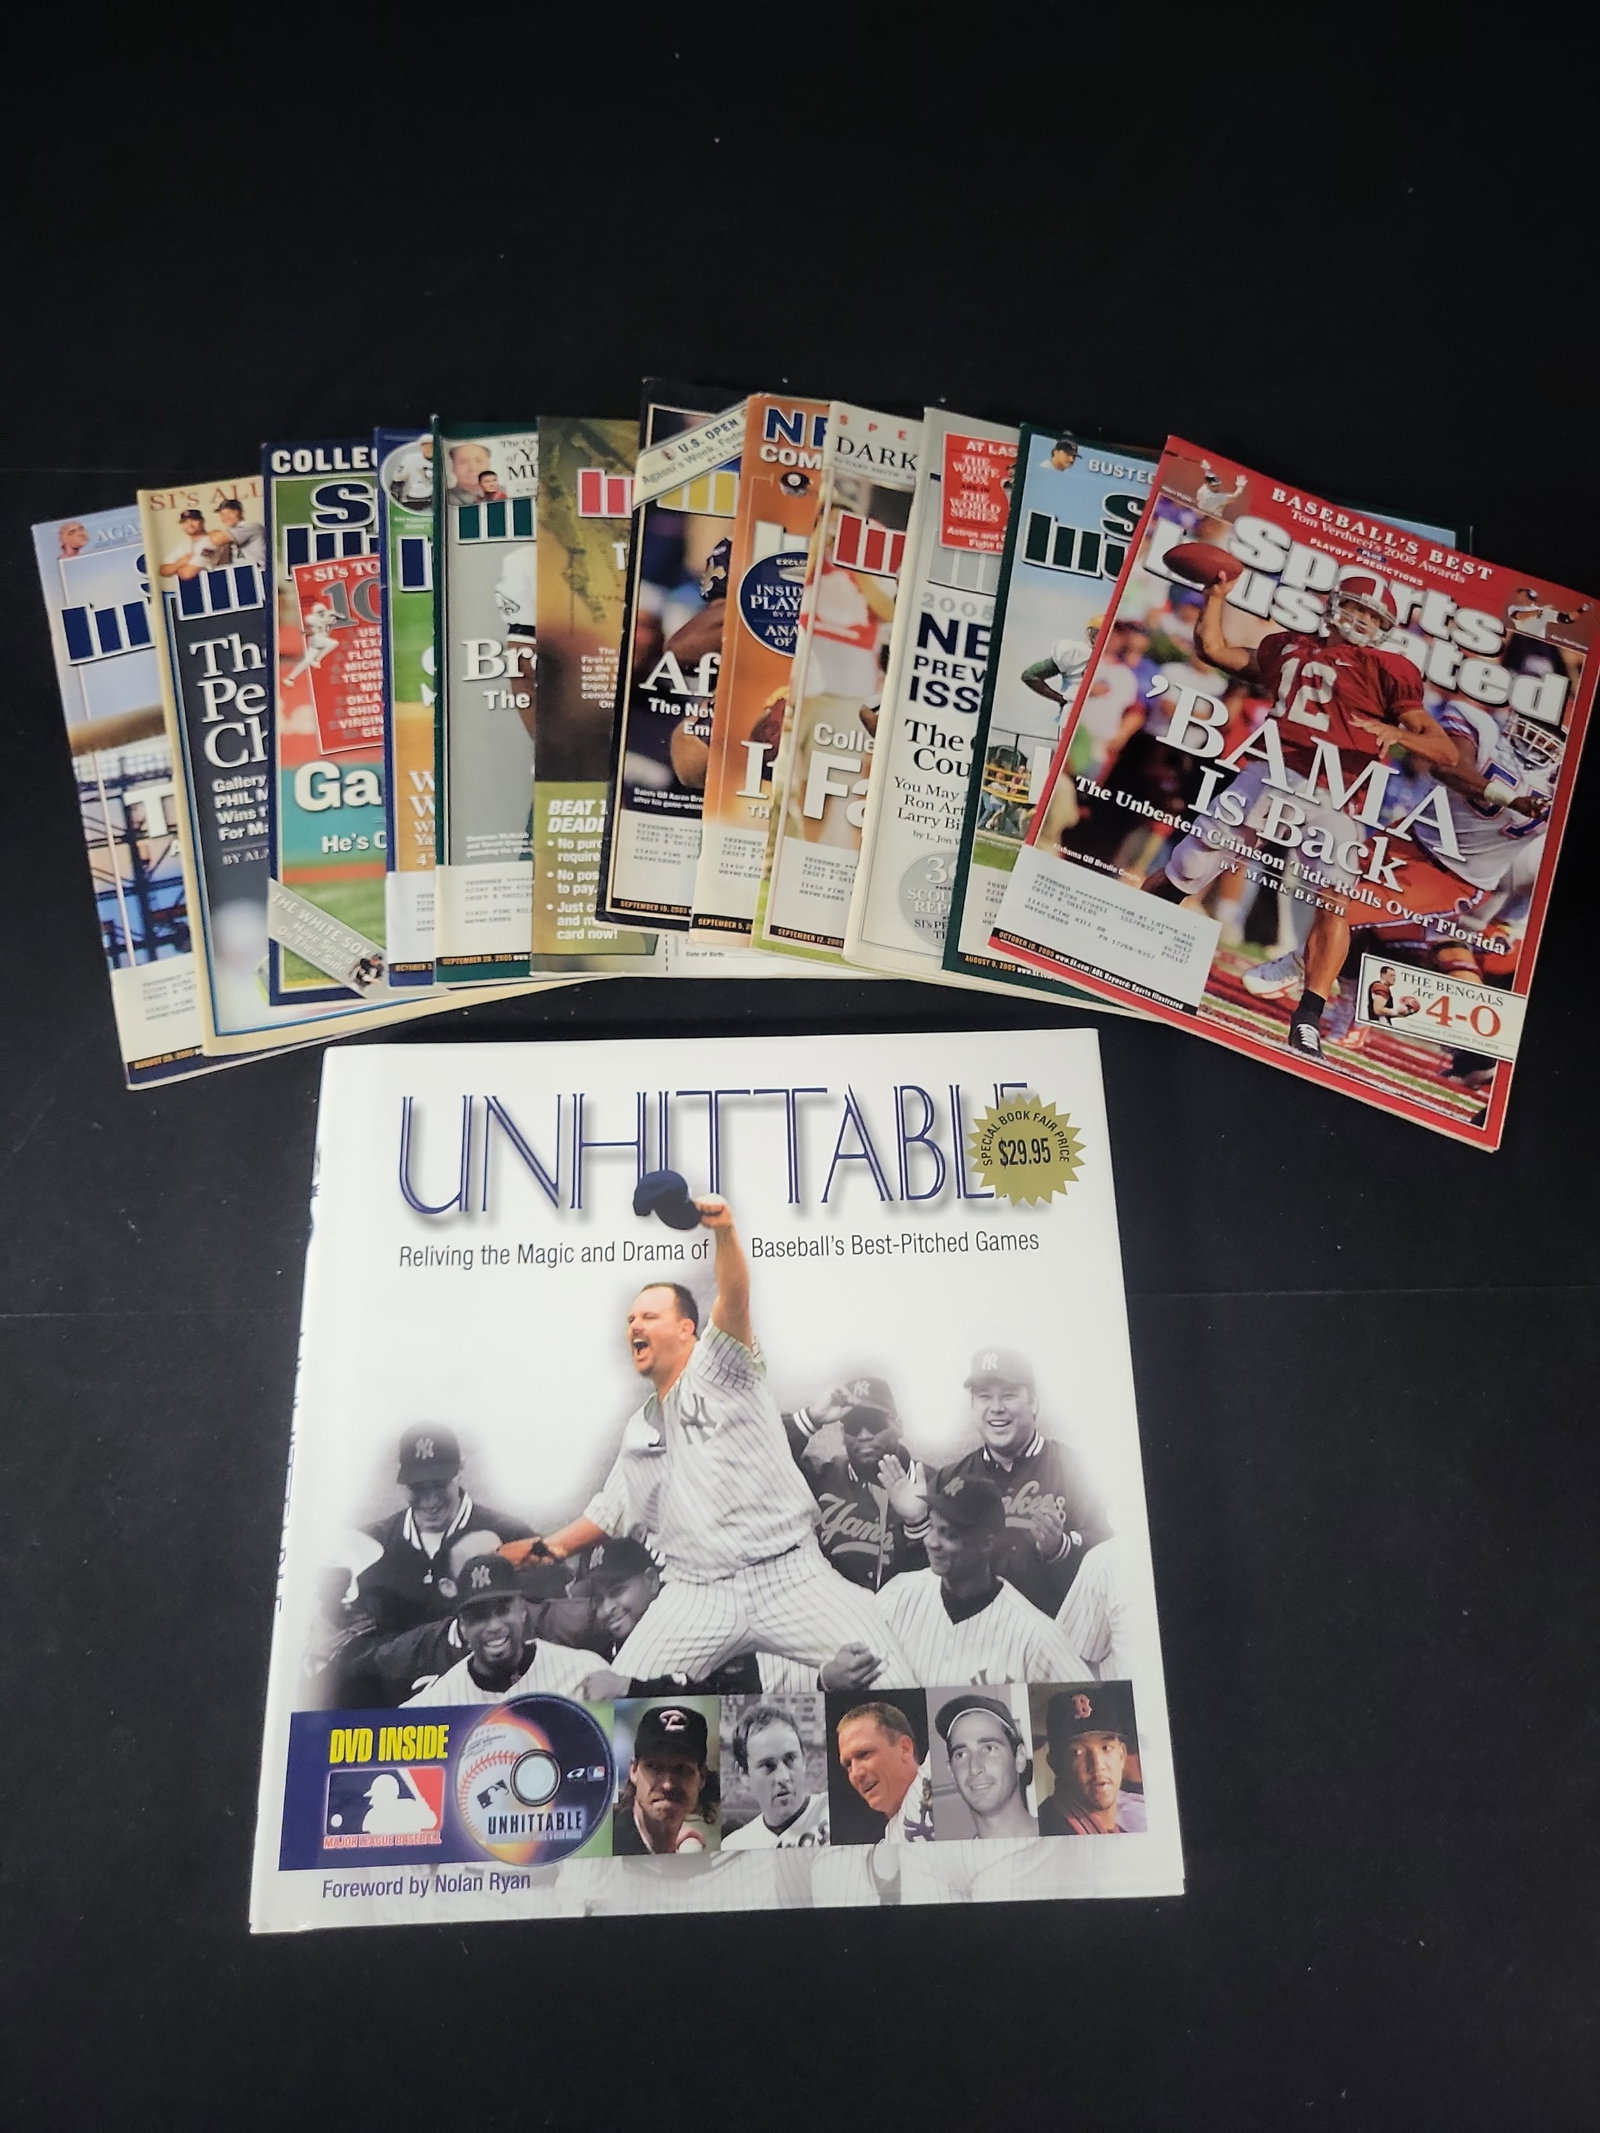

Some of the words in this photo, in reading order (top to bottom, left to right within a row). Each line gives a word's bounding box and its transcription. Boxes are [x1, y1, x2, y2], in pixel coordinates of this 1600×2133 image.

[704, 418, 738, 440] OPEN
[835, 436, 918, 471] DARK
[966, 440, 986, 452] AT
[272, 446, 377, 473] COLLE
[962, 454, 990, 466] THE
[952, 462, 1000, 479] WHITE
[962, 473, 989, 485] SOX
[949, 497, 1001, 514] WORLD
[960, 491, 989, 503] THE
[950, 508, 998, 522] SERIES
[1271, 488, 1418, 555] BASEBALL'S
[1429, 549, 1493, 581] BEST
[1291, 509, 1318, 530] Tom
[1322, 523, 1381, 554] Verducci's
[1384, 546, 1417, 567] 2005
[1419, 561, 1466, 585] Awards
[1361, 549, 1385, 562] PLUS
[1310, 537, 1354, 560] PLAYOFF
[1355, 552, 1424, 586] PREDICTIONS
[483, 689, 531, 711] The
[1269, 658, 1337, 732] 12
[347, 706, 380, 715] OHIO
[648, 697, 681, 715] The
[904, 719, 964, 752] The
[1146, 674, 1466, 863] 'BAMA
[212, 775, 267, 793] Gallery
[894, 776, 922, 794] You
[925, 786, 960, 803] May
[214, 791, 254, 810] PHIL
[548, 800, 595, 815] BEAT
[903, 793, 931, 810] Ron
[216, 809, 257, 825] Wins
[897, 806, 941, 830] Larry
[218, 827, 246, 841] For
[1188, 765, 1248, 827] Is
[1256, 795, 1407, 893] Back
[321, 833, 370, 853] He's
[557, 838, 574, 849] No
[222, 853, 241, 865] BY
[1075, 775, 1113, 801] The
[1116, 790, 1202, 839] Unbeaten
[1207, 827, 1285, 871] Crimson
[1290, 860, 1333, 890] Tide
[1334, 881, 1382, 910] Rolls
[1386, 900, 1434, 928] Over
[1435, 919, 1506, 956] Florida
[557, 870, 574, 880] No
[557, 883, 570, 894] to
[1220, 860, 1239, 874] BY
[1244, 868, 1289, 896] MARK
[1294, 887, 1345, 918] BEECH
[557, 902, 583, 912] Just
[620, 900, 659, 913] SEPTEMBER
[670, 904, 688, 914] 2005
[272, 892, 300, 913] THE
[299, 909, 343, 941] WHITE
[342, 937, 371, 957] SOX
[557, 917, 580, 926] and
[698, 918, 737, 928] SEPTEMBER
[557, 930, 585, 939] card
[588, 930, 618, 939] now!
[778, 927, 816, 943] SEPTEMBER
[965, 954, 993, 970] AUGUST
[999, 962, 1016, 971] 2005
[999, 931, 1027, 947] OCTOBER
[1038, 946, 1054, 958] 2005
[1091, 967, 1103, 977] AOL
[1131, 983, 1151, 997] Sports
[1401, 972, 1431, 988] THE
[1436, 981, 1504, 1007] BENGALS
[1413, 987, 1434, 1000] Are
[1425, 996, 1501, 1037] 4-0
[981, 1124, 1001, 1166] SPECIAL
[998, 1110, 1031, 1126] BOOK
[1032, 1111, 1056, 1132] FAIR
[1053, 1127, 1070, 1163] PRICE
[998, 1137, 1052, 1167] $29.95
[399, 1245, 474, 1270] Reliving
[481, 1244, 510, 1265] the
[517, 1242, 575, 1268] Magic
[581, 1242, 615, 1263] and
[623, 1240, 686, 1262] Drama
[691, 1238, 710, 1260] of
[751, 1235, 845, 1258] Baseball's
[851, 1230, 969, 1255] Best-Pitched
[975, 1230, 1040, 1252] Games
[329, 1729, 373, 1764] DVD
[378, 1724, 450, 1762] INSIDE
[488, 1812, 583, 1835] UNHITTABLE
[324, 1835, 358, 1849] MAJOR
[359, 1834, 395, 1847] LEAGUE
[396, 1832, 442, 1846] BASEBALL
[322, 1875, 403, 1898] Foreword
[409, 1876, 429, 1896] by
[435, 1873, 483, 1893] Nolan
[490, 1872, 531, 1891] Ryan
